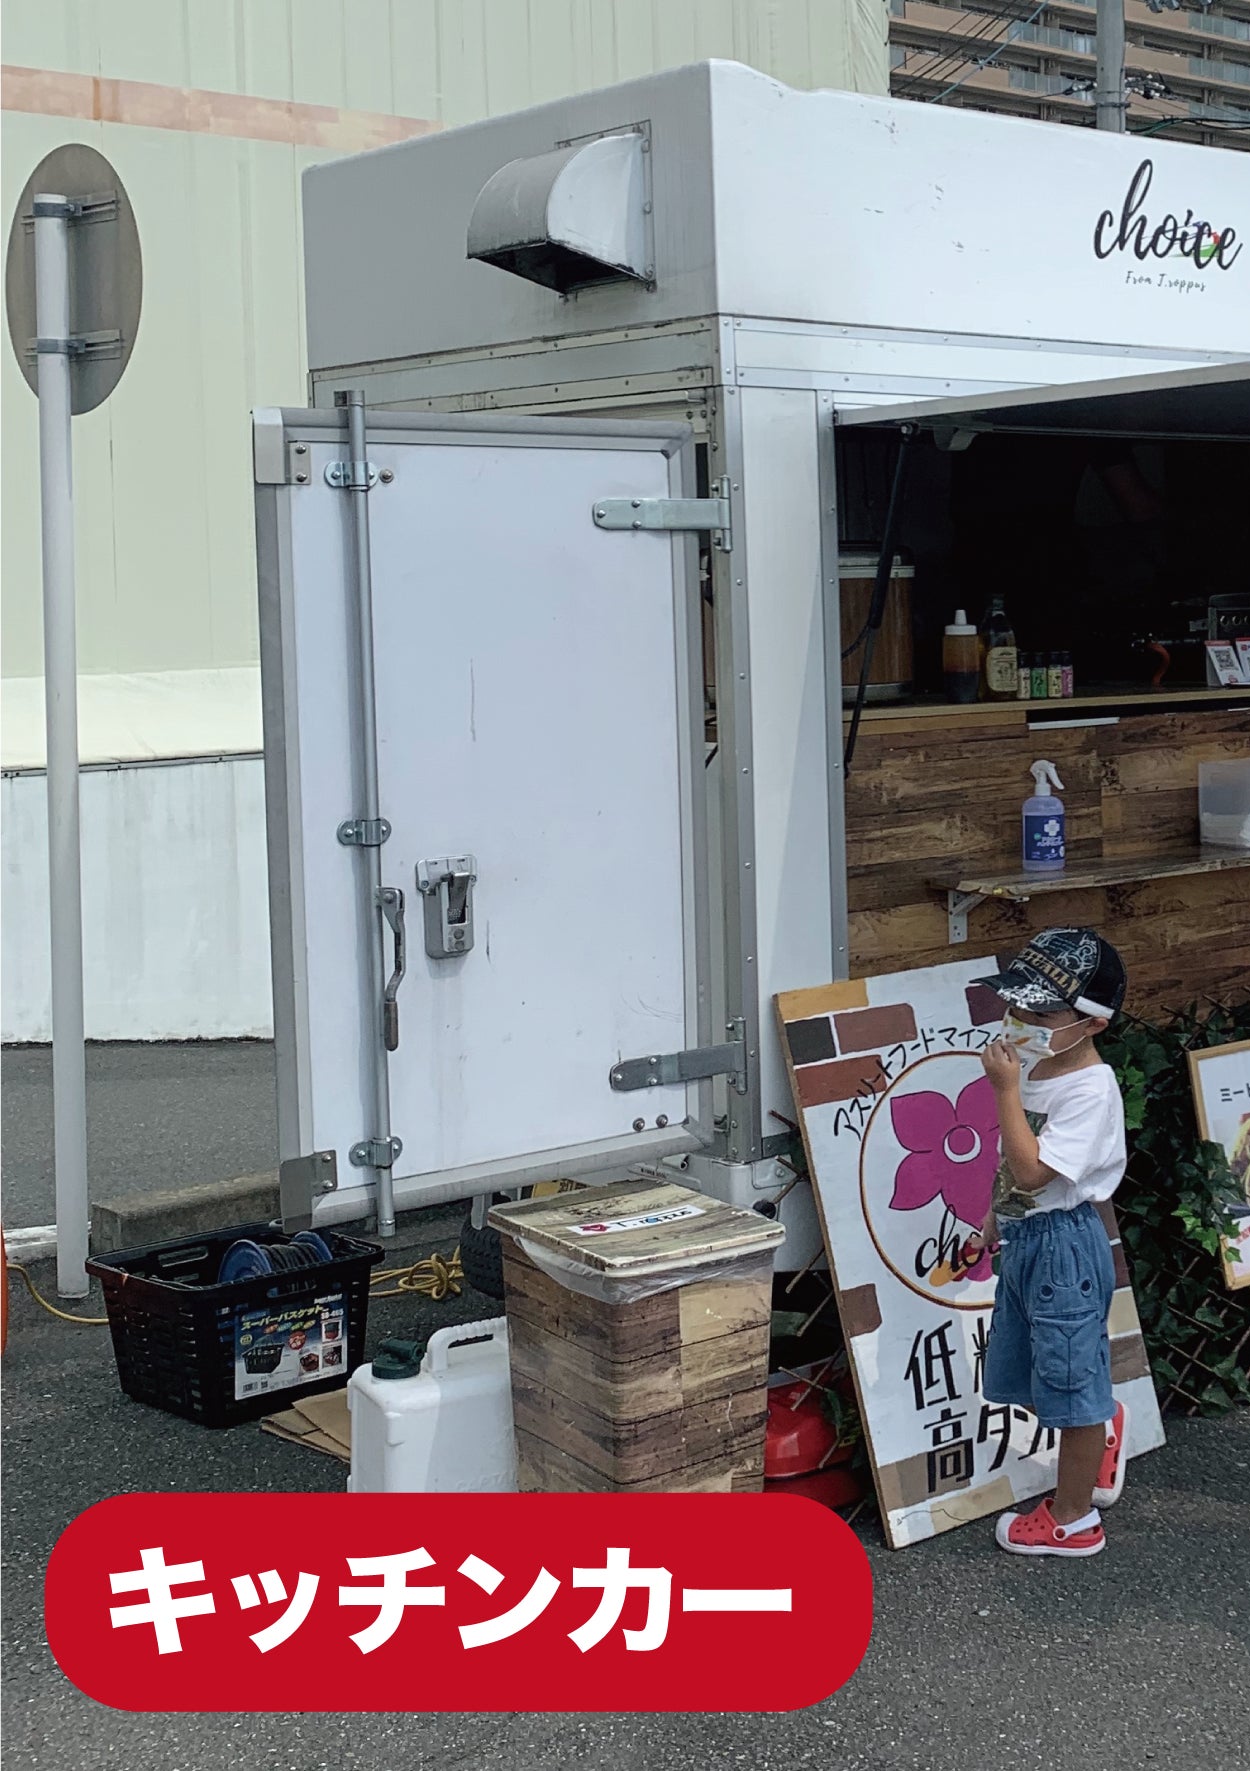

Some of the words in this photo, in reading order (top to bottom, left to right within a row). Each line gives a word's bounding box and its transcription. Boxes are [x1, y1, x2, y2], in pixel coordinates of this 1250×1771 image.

[1094, 158, 1243, 270] choice
[241, 1305, 324, 1331] スーパーバスケット
